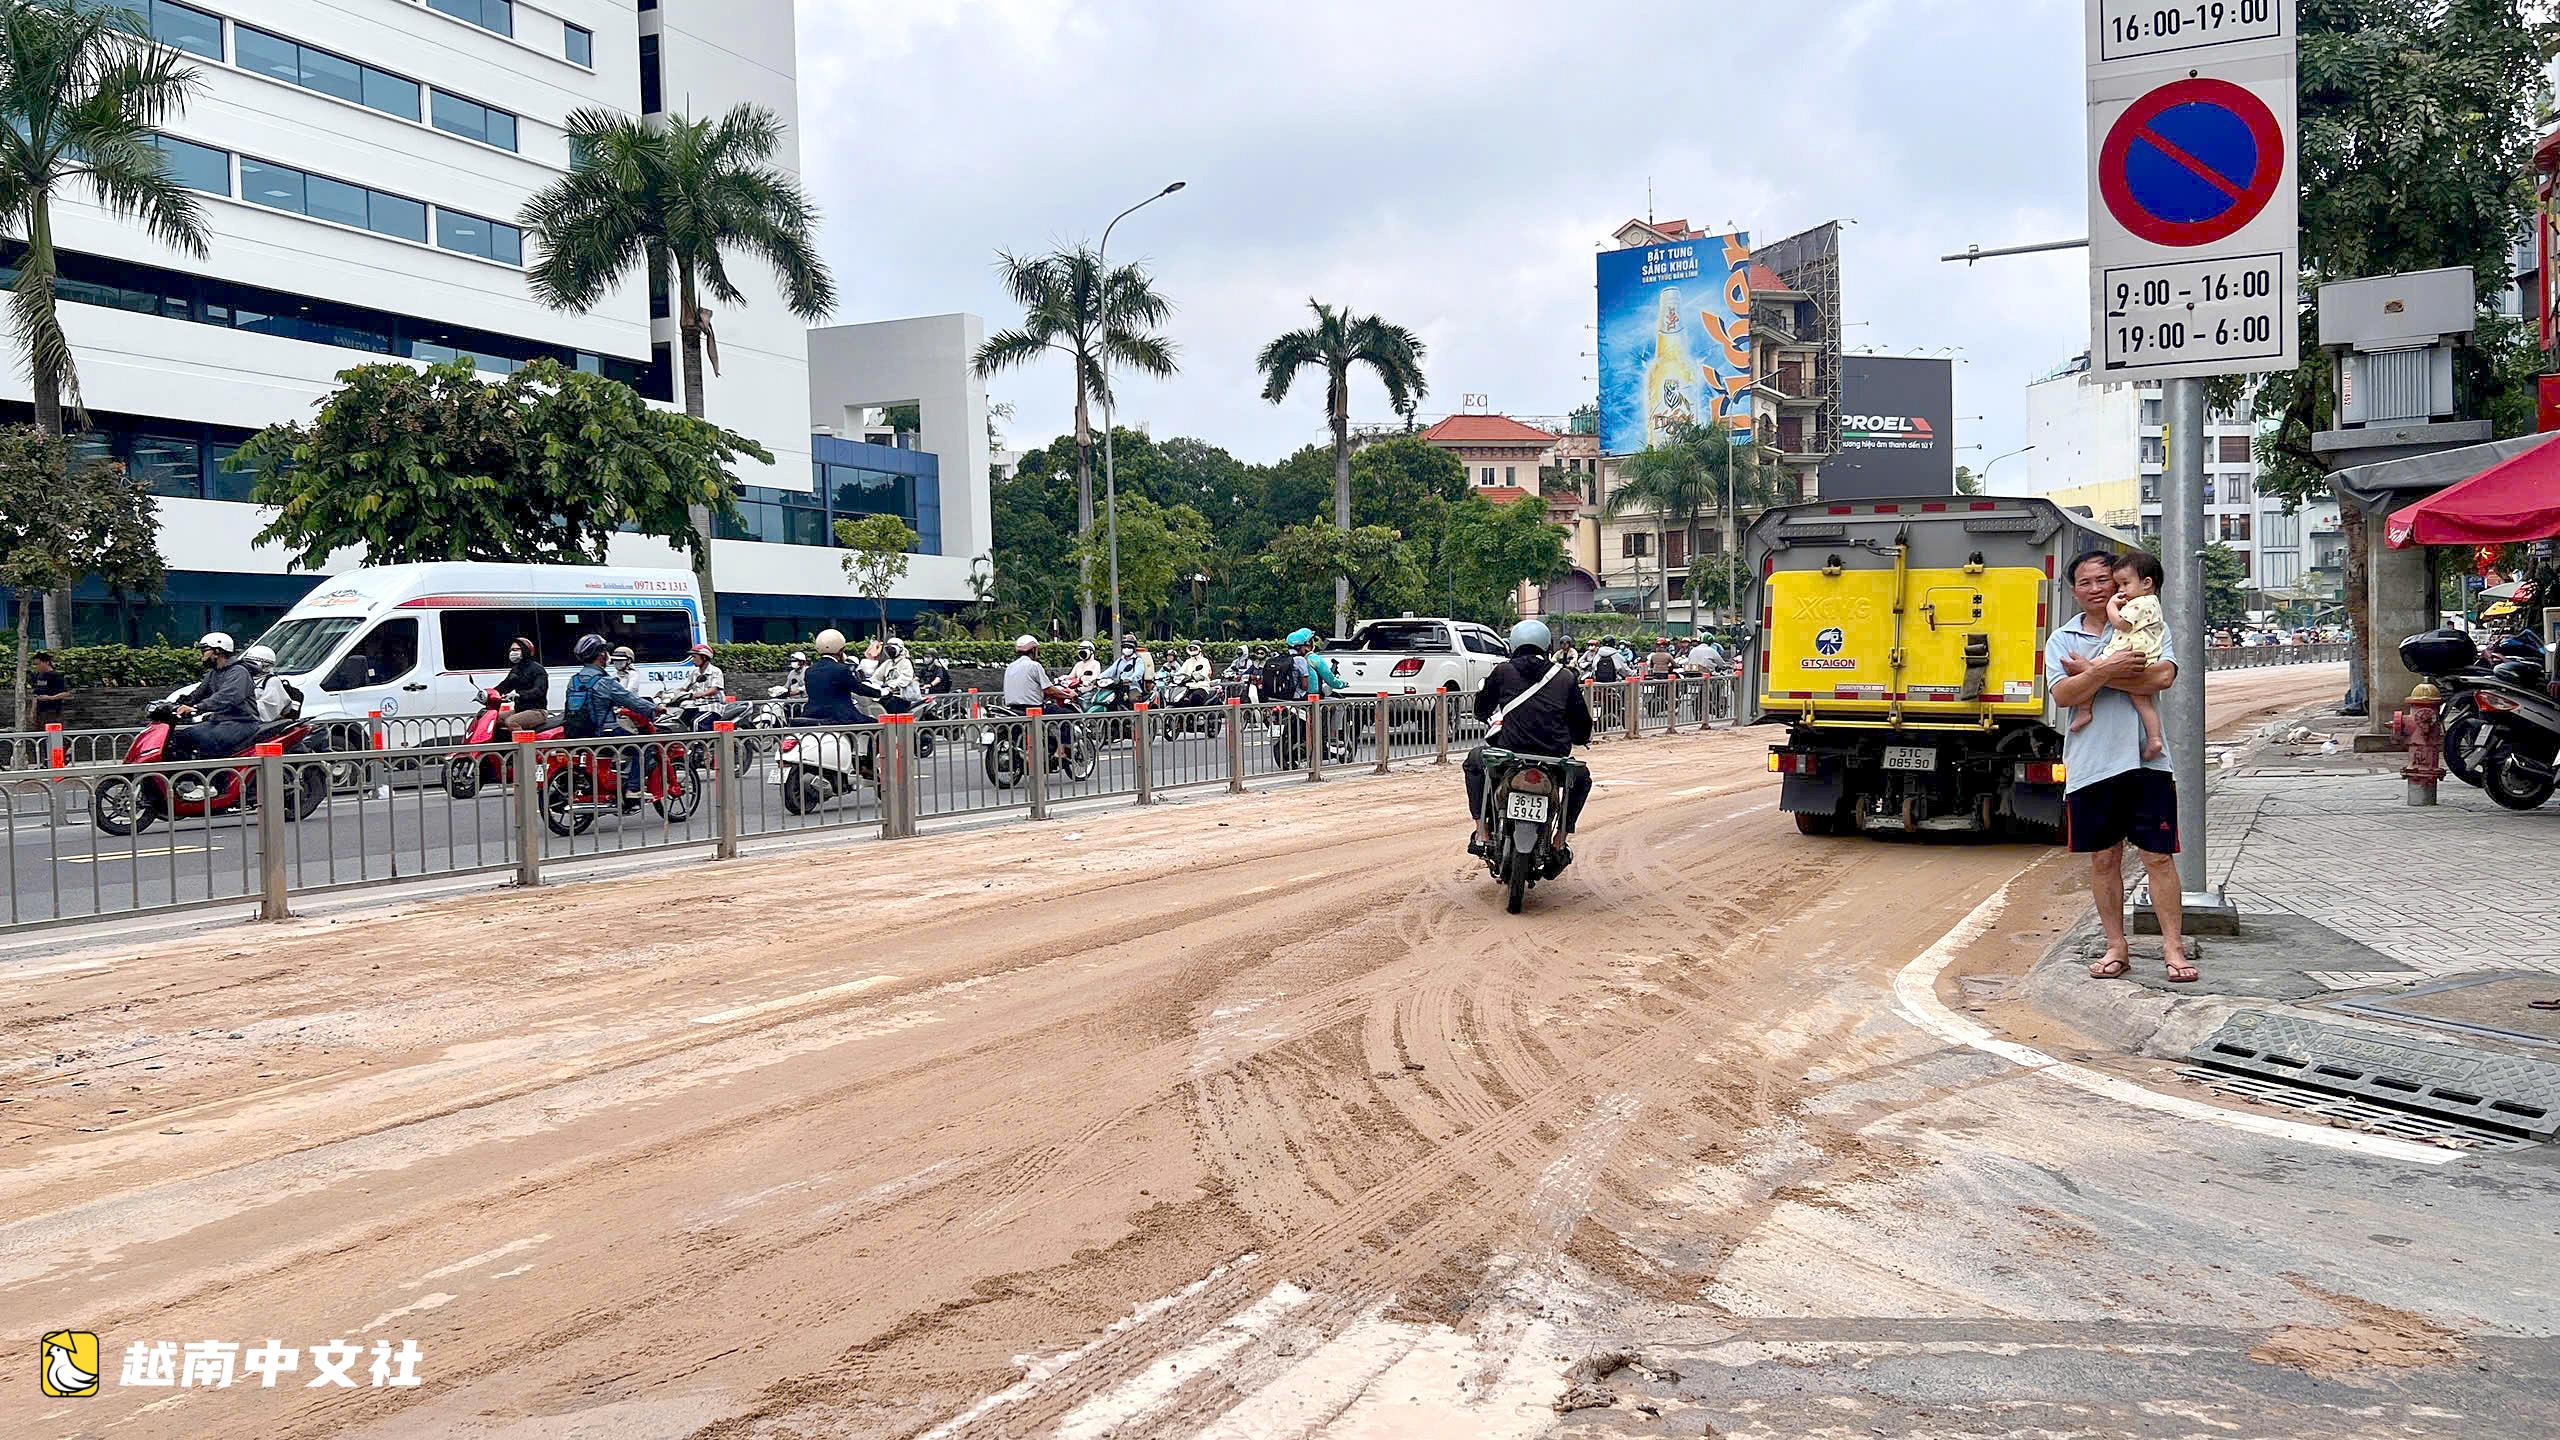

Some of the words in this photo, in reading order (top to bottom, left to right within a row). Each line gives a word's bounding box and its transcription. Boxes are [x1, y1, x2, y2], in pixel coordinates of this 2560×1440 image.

[2111, 0, 2269, 43] 16:00-19:00
[1667, 246, 1694, 260] TUNG
[2117, 280, 2170, 310] 9:00
[2201, 270, 2270, 302] 16:00
[2117, 322, 2185, 353] 19:00
[2215, 315, 2270, 346] 6:00
[1841, 414, 1913, 431] PROEL
[656, 581, 667, 590] 52
[1899, 748, 1921, 759] 51C
[1888, 758, 1930, 769] 085.90
[1513, 806, 1542, 819] 5944
